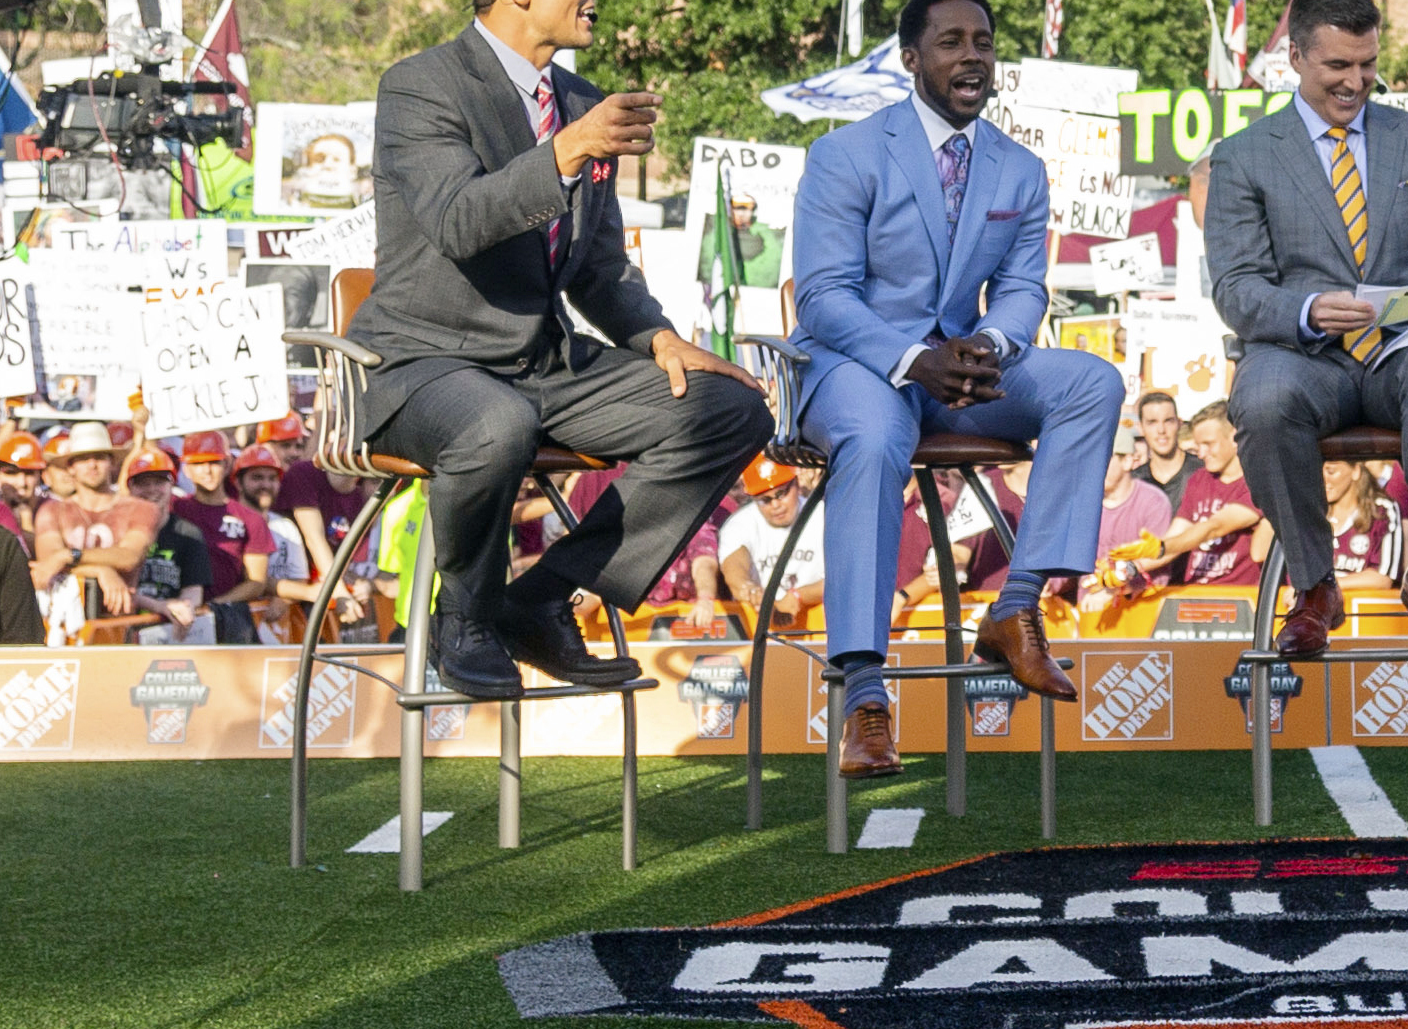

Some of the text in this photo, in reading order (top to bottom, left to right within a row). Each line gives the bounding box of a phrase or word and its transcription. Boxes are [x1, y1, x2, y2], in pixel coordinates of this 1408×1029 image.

[701, 144, 781, 169] DABO
[1101, 170, 1133, 198] NOT
[1070, 200, 1128, 235] BLACK
[60, 229, 105, 251] The
[233, 333, 252, 362] A
[2, 669, 33, 701] THE
[145, 672, 198, 684] COLLEGE
[691, 668, 743, 679] COLLEGE
[1092, 661, 1130, 697] THE
[1231, 677, 1297, 692] GADAY
[1361, 661, 1399, 693] THE
[136, 685, 207, 700] GAMEDAY
[1084, 651, 1173, 740] HOME
[15, 693, 76, 750] DEPOT
[1118, 683, 1172, 740] DEPOT
